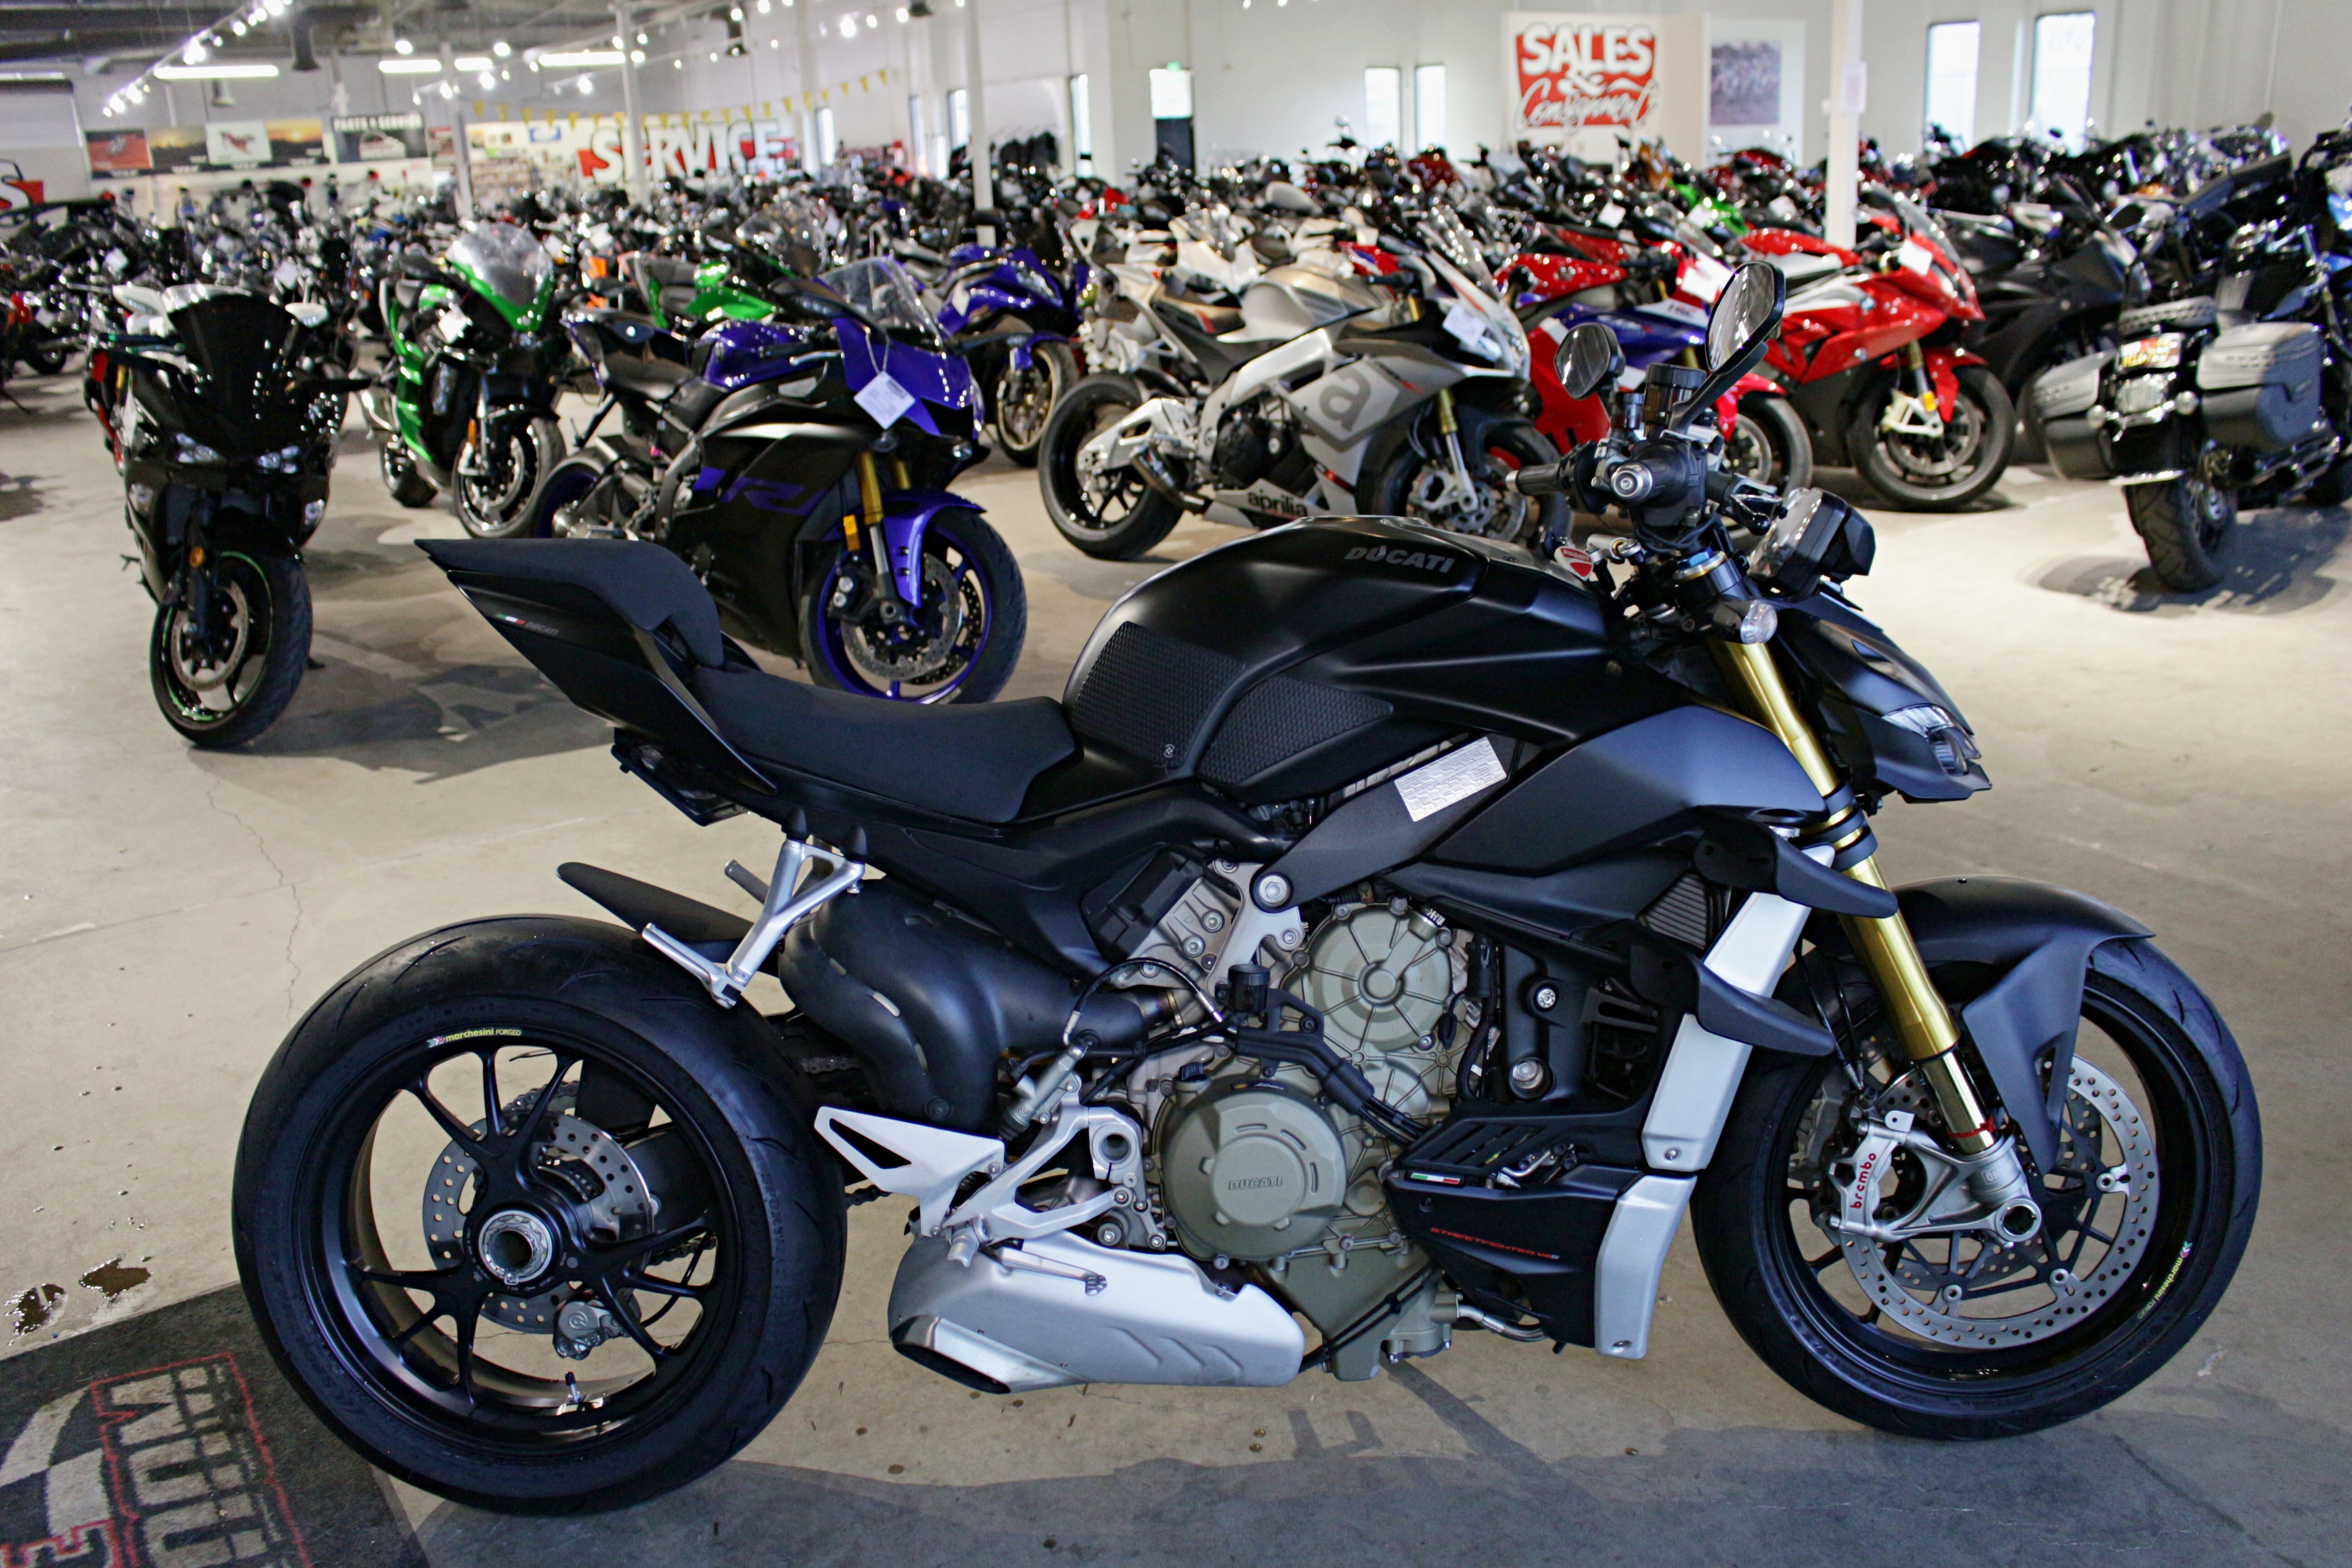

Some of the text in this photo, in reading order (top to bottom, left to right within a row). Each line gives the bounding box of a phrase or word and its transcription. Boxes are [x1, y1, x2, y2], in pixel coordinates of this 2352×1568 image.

[1521, 23, 1654, 76] SALES
[1557, 68, 1604, 96] &
[1514, 77, 1659, 136] Consignment
[591, 119, 787, 182] SERVICE
[1248, 492, 1308, 516] aprilia
[1344, 546, 1455, 573] DUCATI
[445, 1028, 494, 1043] marchesini
[1228, 1176, 1282, 1190] DUCATI
[1849, 1153, 1877, 1209] brembo
[1430, 1227, 1535, 1255] STREETFIGHTER
[2154, 1257, 2183, 1300] marchesini
